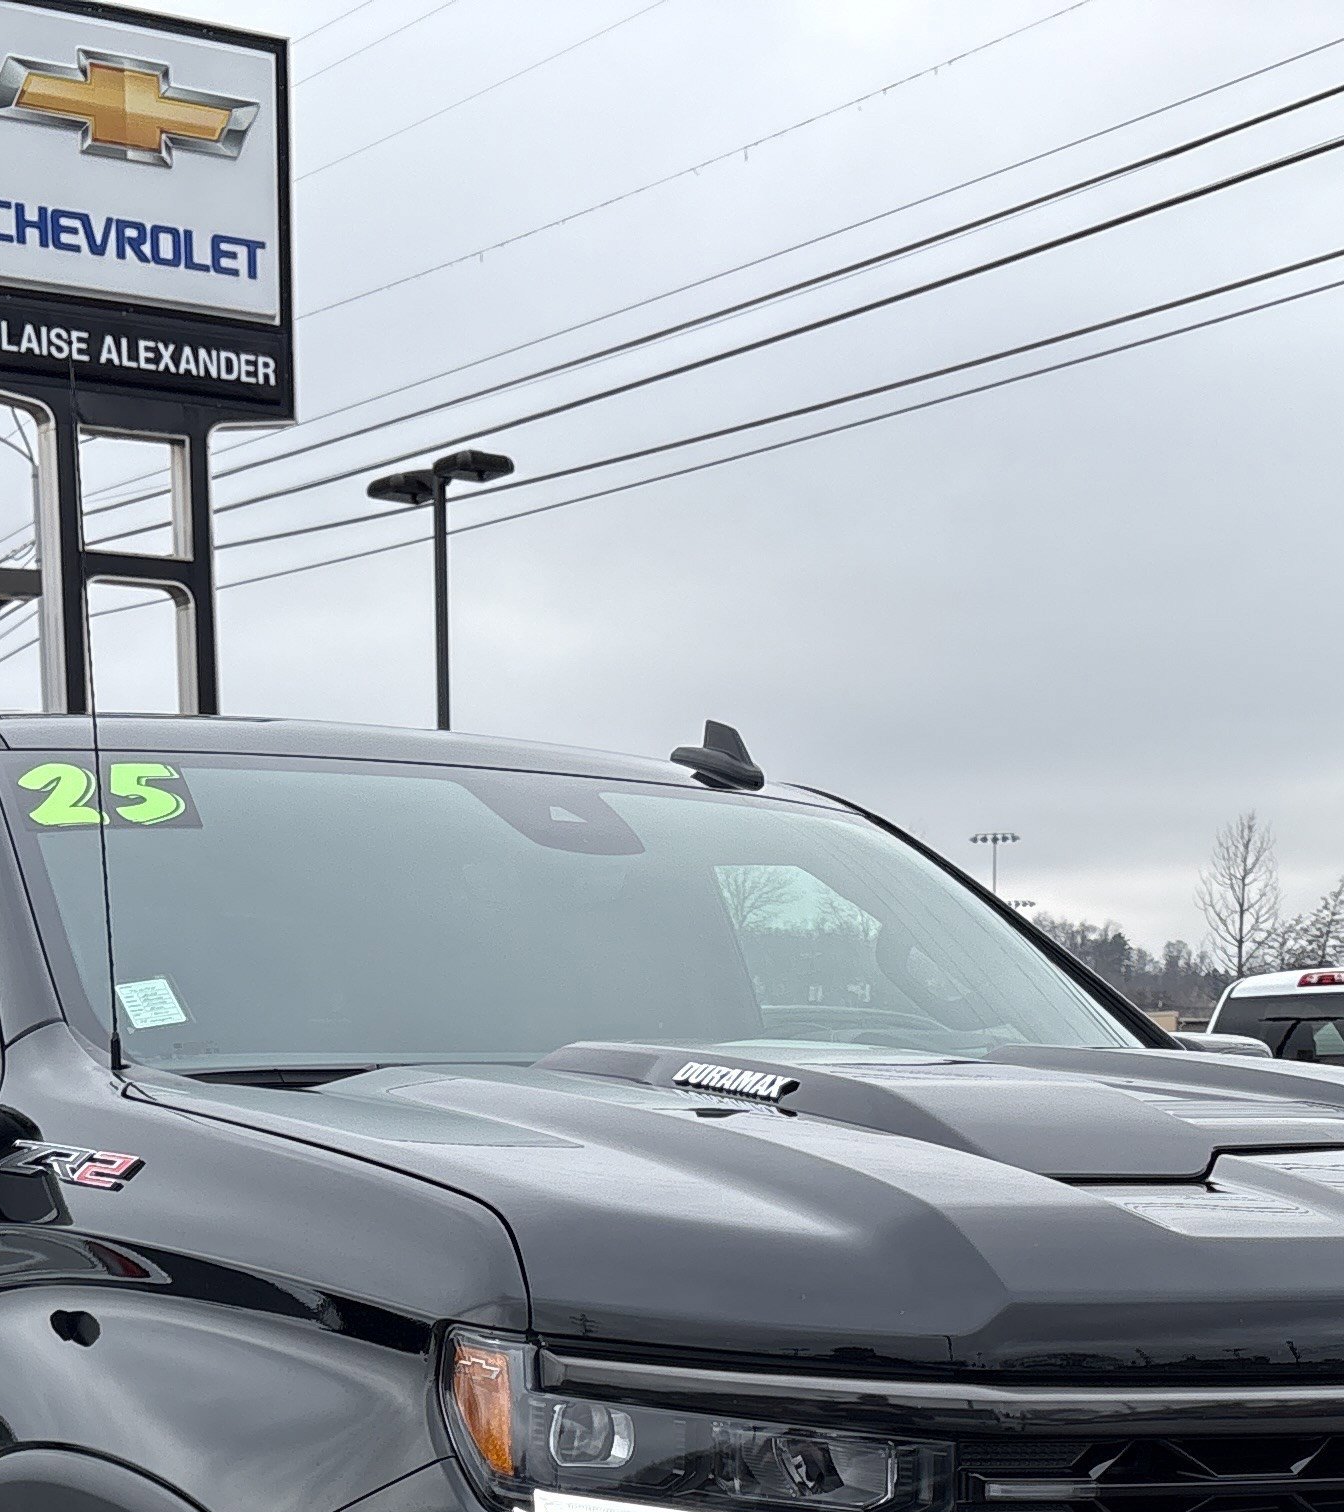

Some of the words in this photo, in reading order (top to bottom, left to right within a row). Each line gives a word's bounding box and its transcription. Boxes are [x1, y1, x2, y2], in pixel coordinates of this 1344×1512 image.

[99, 335, 277, 386] ALEXANDER
[17, 762, 186, 827] 25
[672, 1061, 793, 1100] DURAMAX
